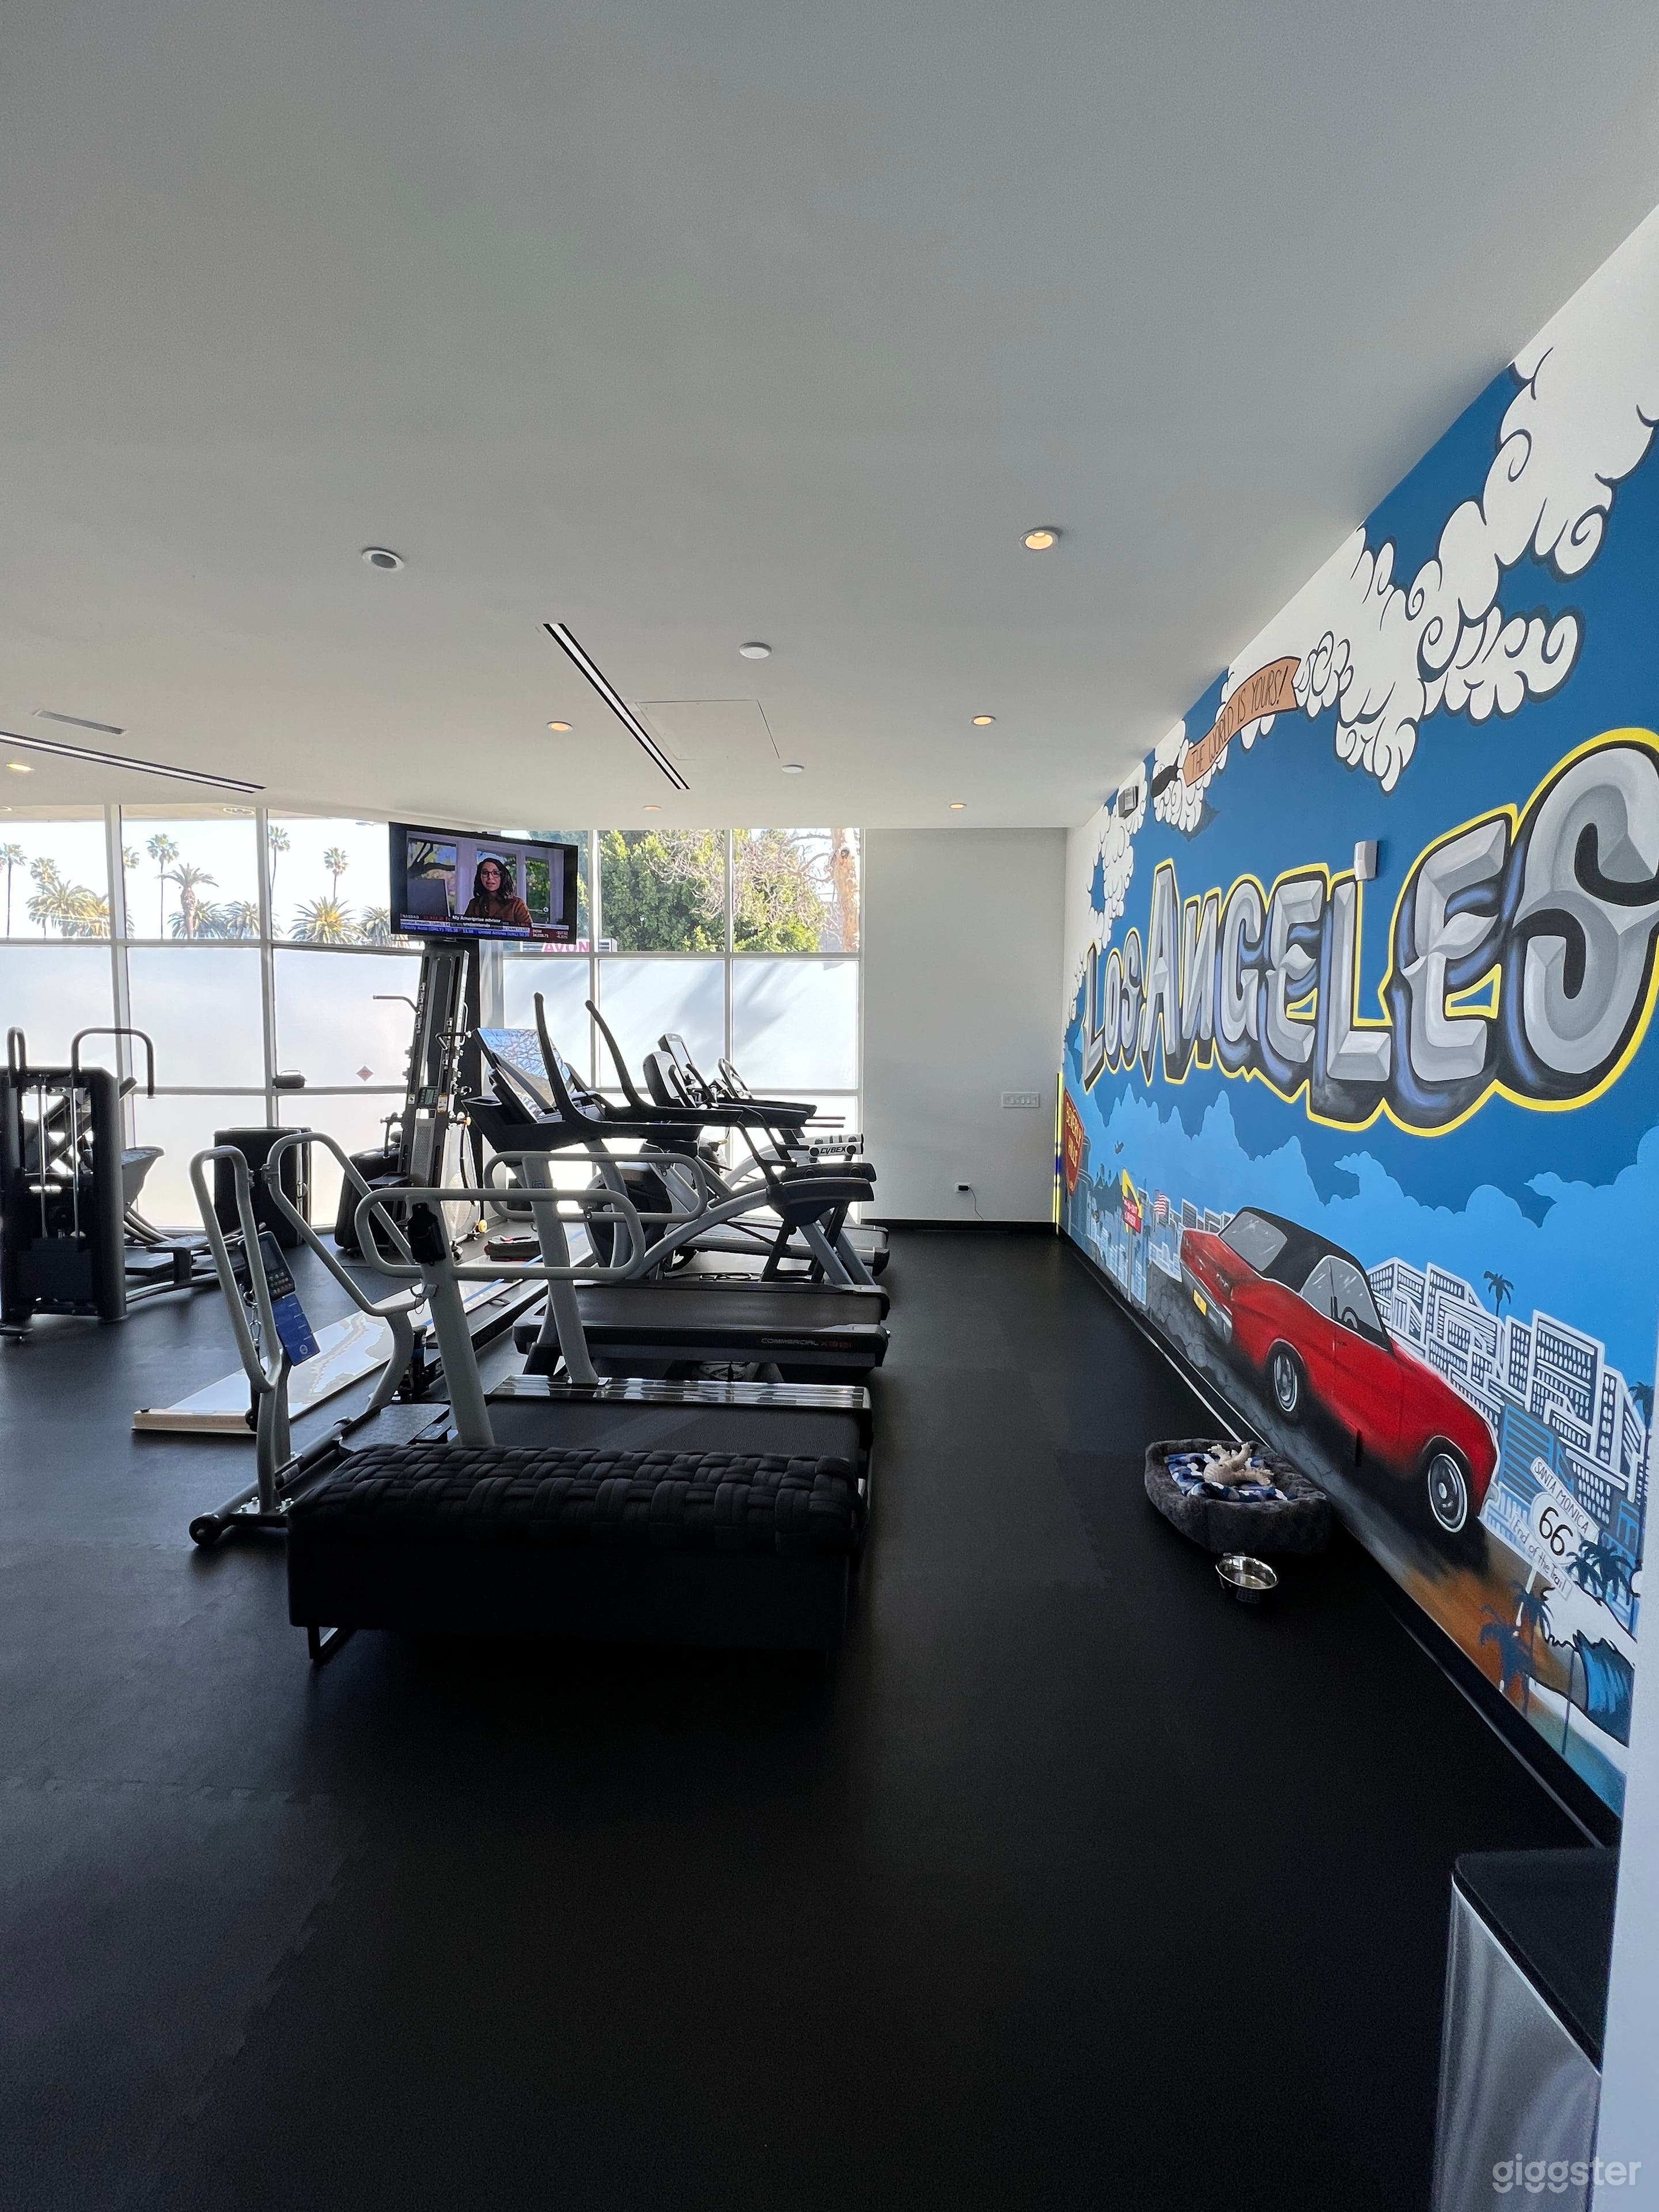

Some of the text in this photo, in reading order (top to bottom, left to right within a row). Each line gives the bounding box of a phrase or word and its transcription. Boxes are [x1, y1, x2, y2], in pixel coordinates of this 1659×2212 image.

[1191, 665, 1290, 777] THE WORLD IS YOURS!
[543, 941, 589, 952] AVON
[820, 1146, 847, 1155] CYBEX
[1533, 1461, 1590, 1534] SANTA MONICA
[1512, 1520, 1567, 1593] End of the Trail
[1539, 1506, 1574, 1556] 66
